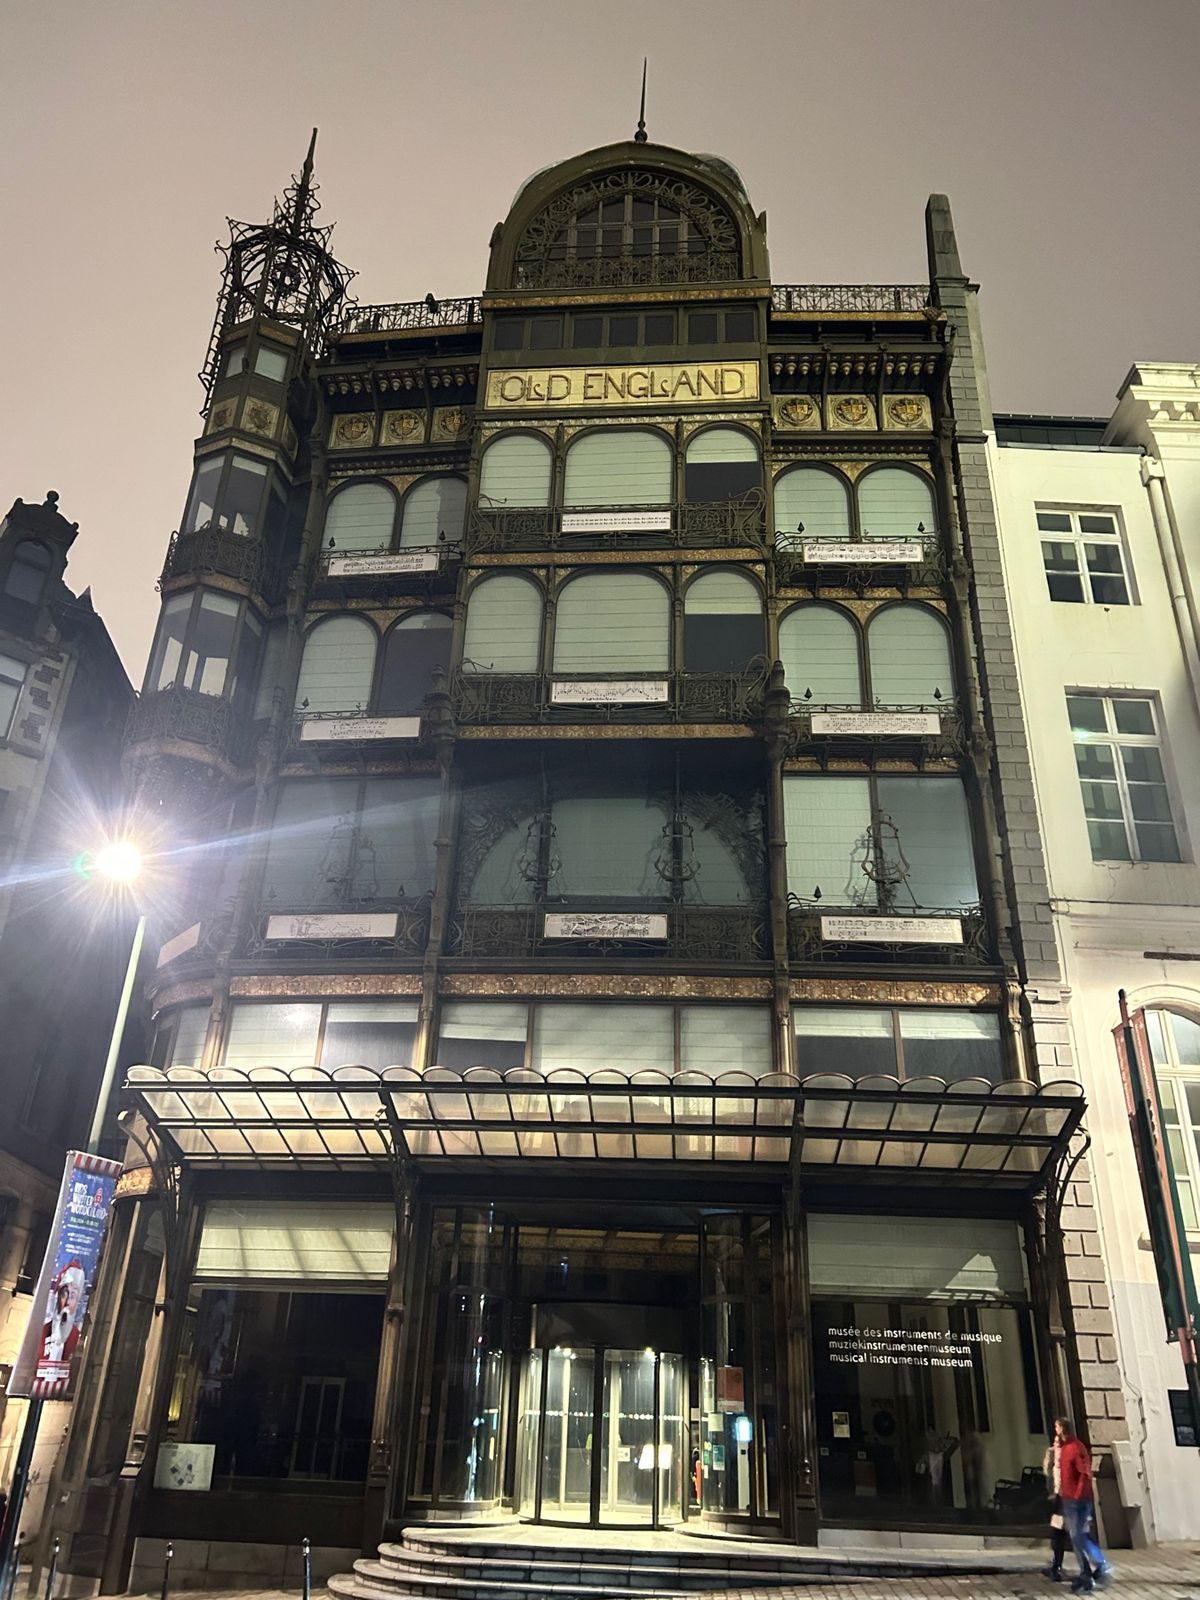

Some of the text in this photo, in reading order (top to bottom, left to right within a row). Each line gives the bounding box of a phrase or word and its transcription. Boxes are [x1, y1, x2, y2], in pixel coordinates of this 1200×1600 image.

[500, 367, 745, 402] OLD ENGLAND
[828, 1326, 1002, 1345] musée des instruments de musique
[829, 1340, 971, 1354] muziekinstrumentenmuseum
[829, 1352, 973, 1368] musical instruments museum
